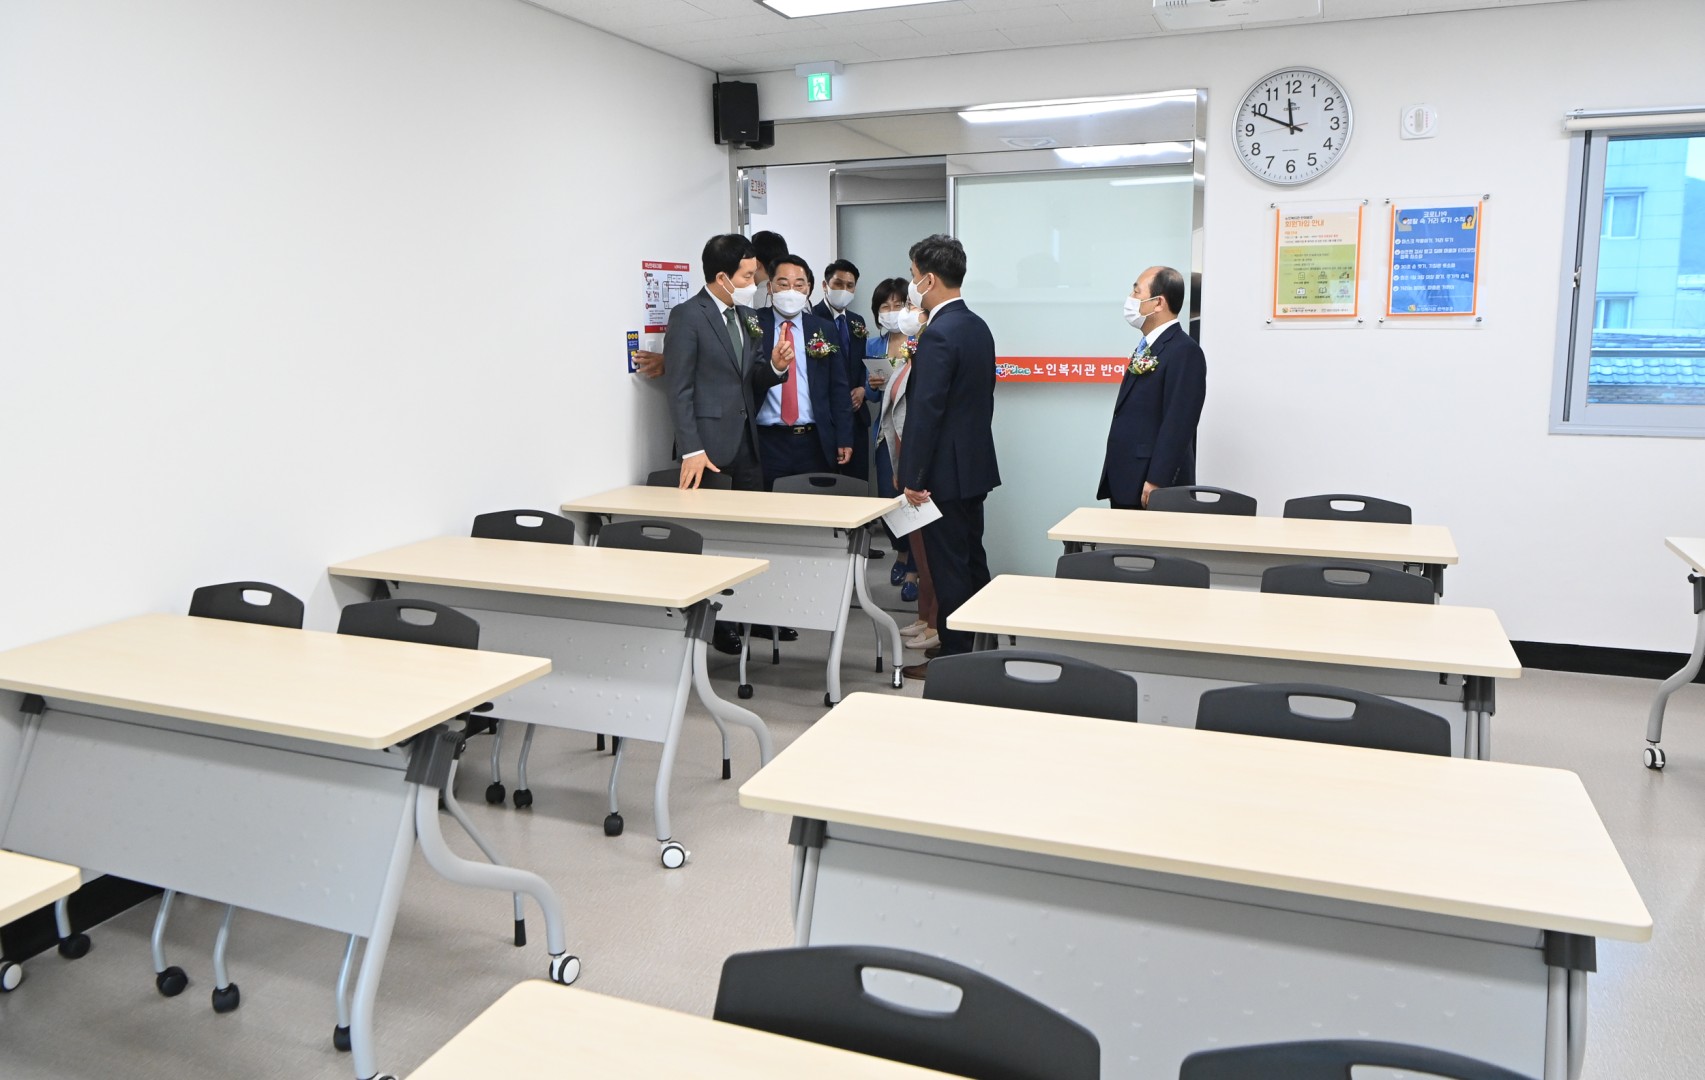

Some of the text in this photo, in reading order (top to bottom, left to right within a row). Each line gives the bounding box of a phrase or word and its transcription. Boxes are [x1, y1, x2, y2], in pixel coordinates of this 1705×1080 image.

[1266, 87, 1278, 101] 11
[1285, 80, 1302, 94] 12
[1310, 83, 1316, 97] 1
[1251, 102, 1268, 117] 10
[1324, 97, 1334, 111] 2
[1245, 123, 1255, 137] 9
[1330, 116, 1340, 130] 3
[1251, 142, 1261, 156] 8
[1323, 137, 1333, 150] 4
[1265, 156, 1275, 169] 7
[1286, 159, 1296, 173] 6
[1307, 153, 1317, 166] 5
[1285, 219, 1325, 228] 회원가입 안내
[1033, 363, 1125, 377] 노인복지관 반여
